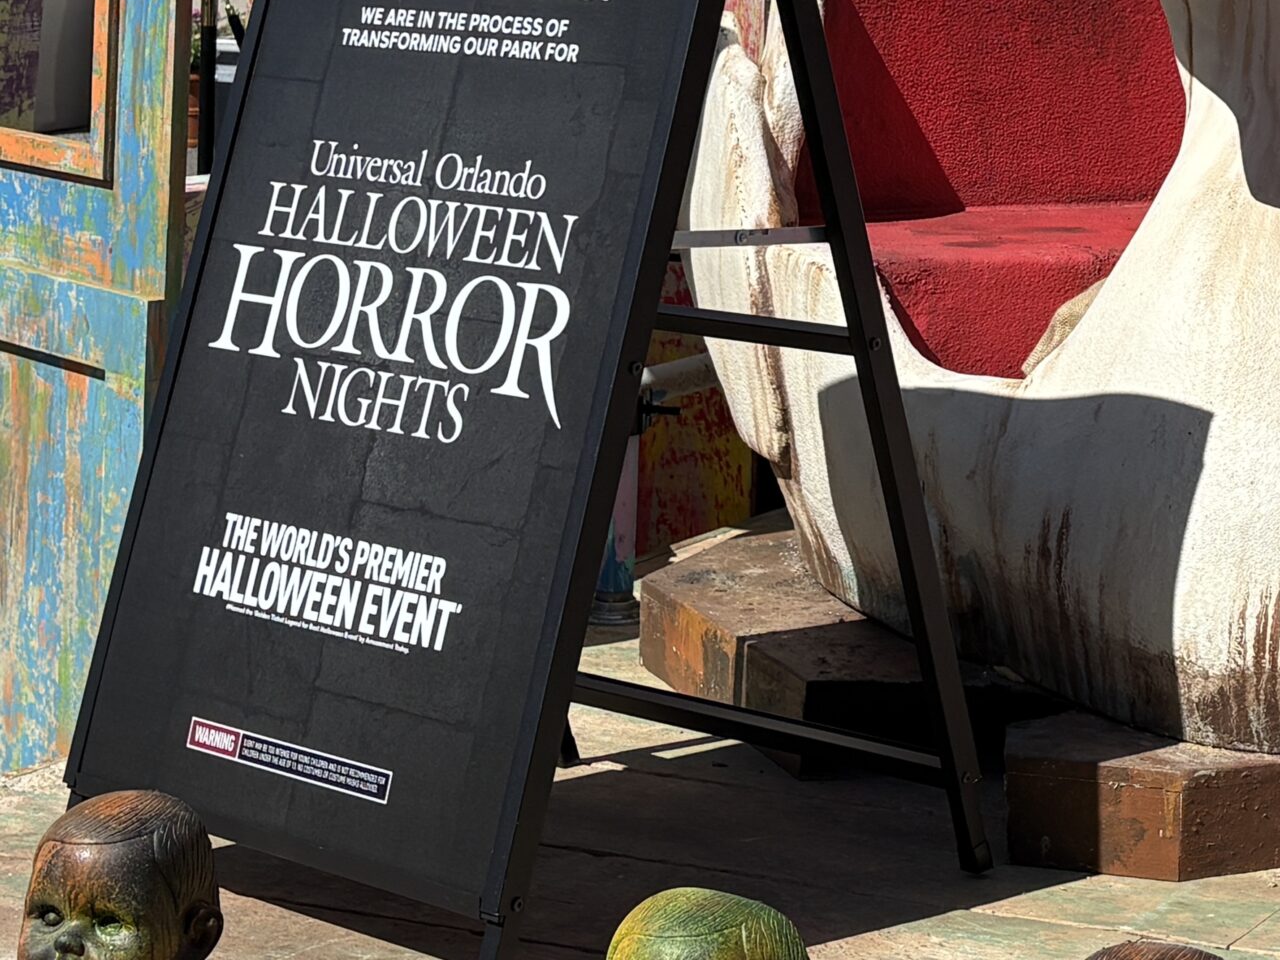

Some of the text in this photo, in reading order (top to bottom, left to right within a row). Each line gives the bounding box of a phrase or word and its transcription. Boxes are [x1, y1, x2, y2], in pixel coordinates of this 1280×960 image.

[342, 28, 580, 63] TRANSFORMING OUR PARK FOR
[361, 7, 570, 38] WE ARE IN THE PROCESS OF
[311, 140, 547, 200] Universal Orlando
[258, 181, 579, 274] HALLOWEEN
[208, 243, 571, 430] HORROR
[281, 357, 470, 444] NIGHTS
[193, 546, 362, 630] HALLOWEEN
[222, 512, 447, 595] THE WORLD'S PREMIER
[195, 724, 236, 752] WARNING
